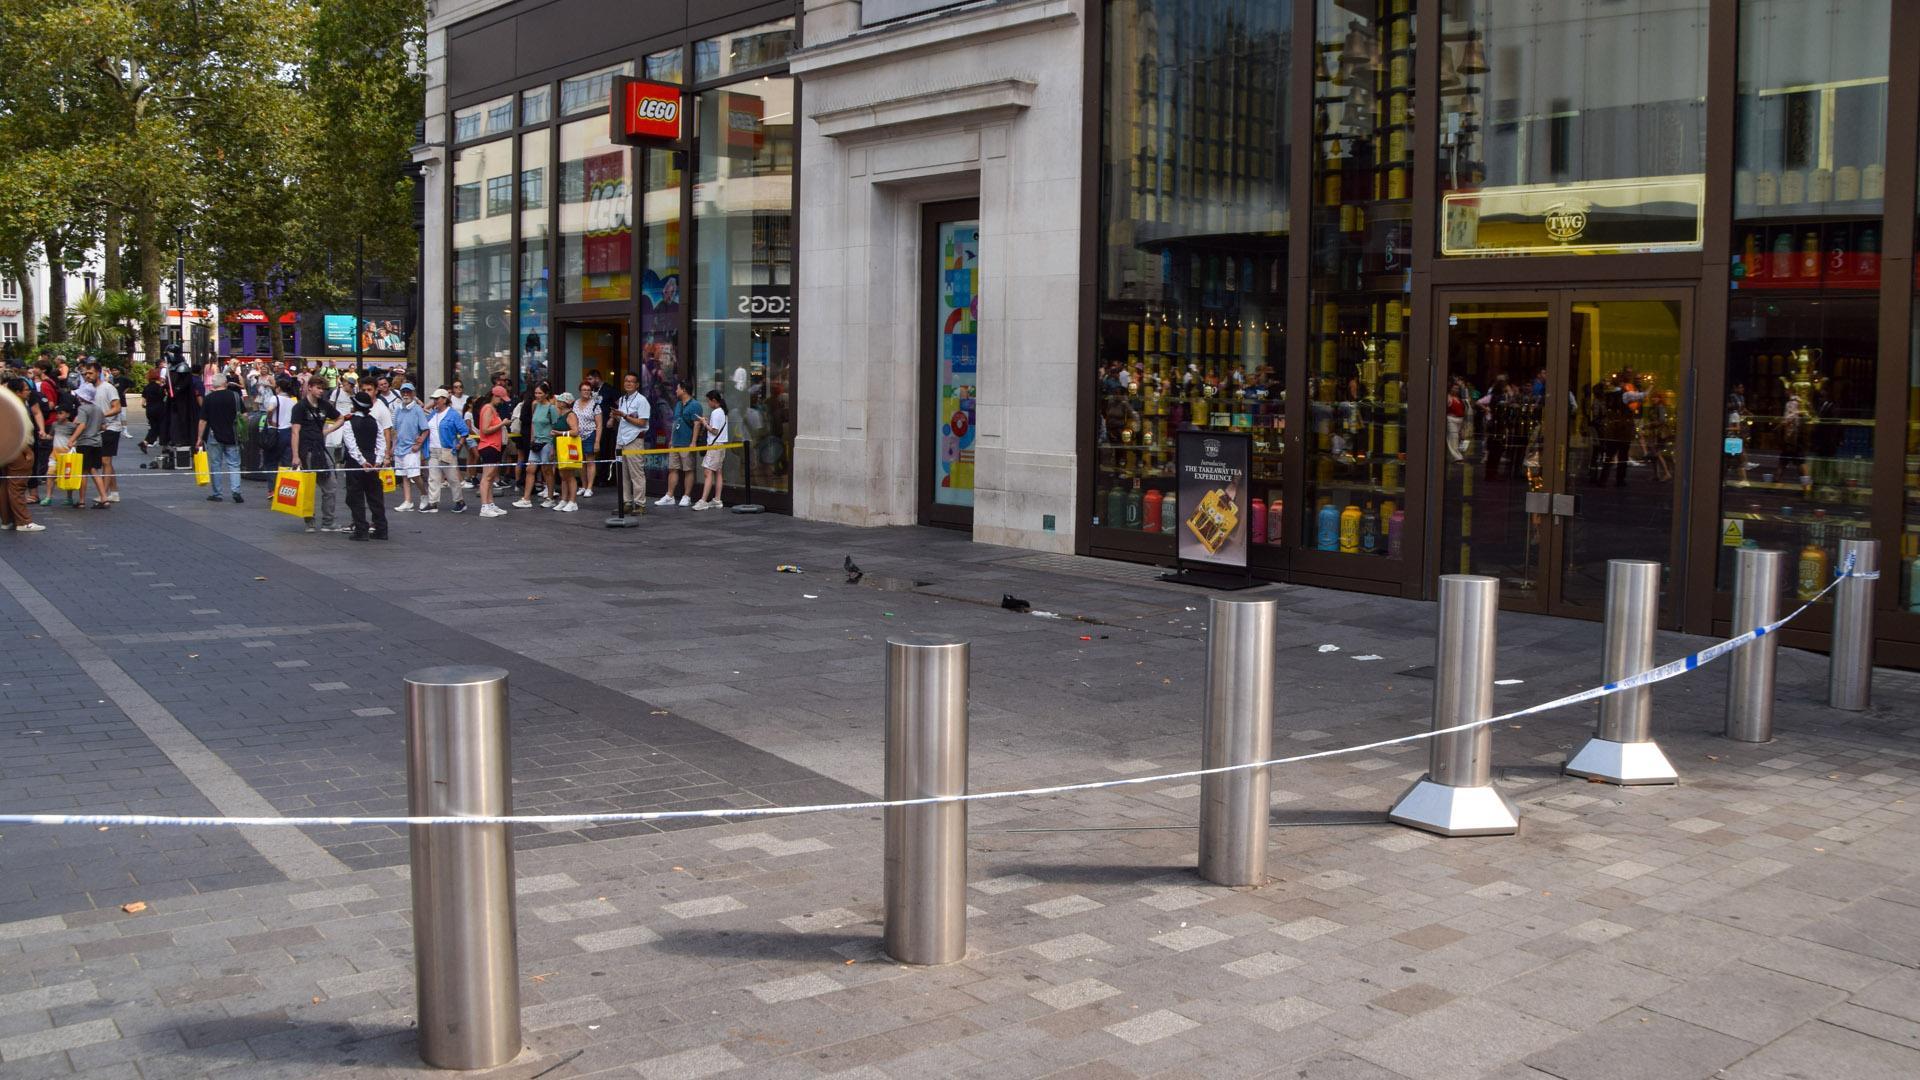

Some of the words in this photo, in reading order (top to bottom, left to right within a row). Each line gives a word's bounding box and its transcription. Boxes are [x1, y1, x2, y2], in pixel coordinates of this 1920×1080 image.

[639, 99, 677, 121] LEGO
[1548, 215, 1583, 230] TWG
[1831, 248, 1844, 268] 3
[1194, 473, 1232, 482] EXPERIENCE
[1198, 466, 1230, 475] TAKEAWAY
[1230, 468, 1242, 476] TEA
[279, 486, 297, 497] LEGO
